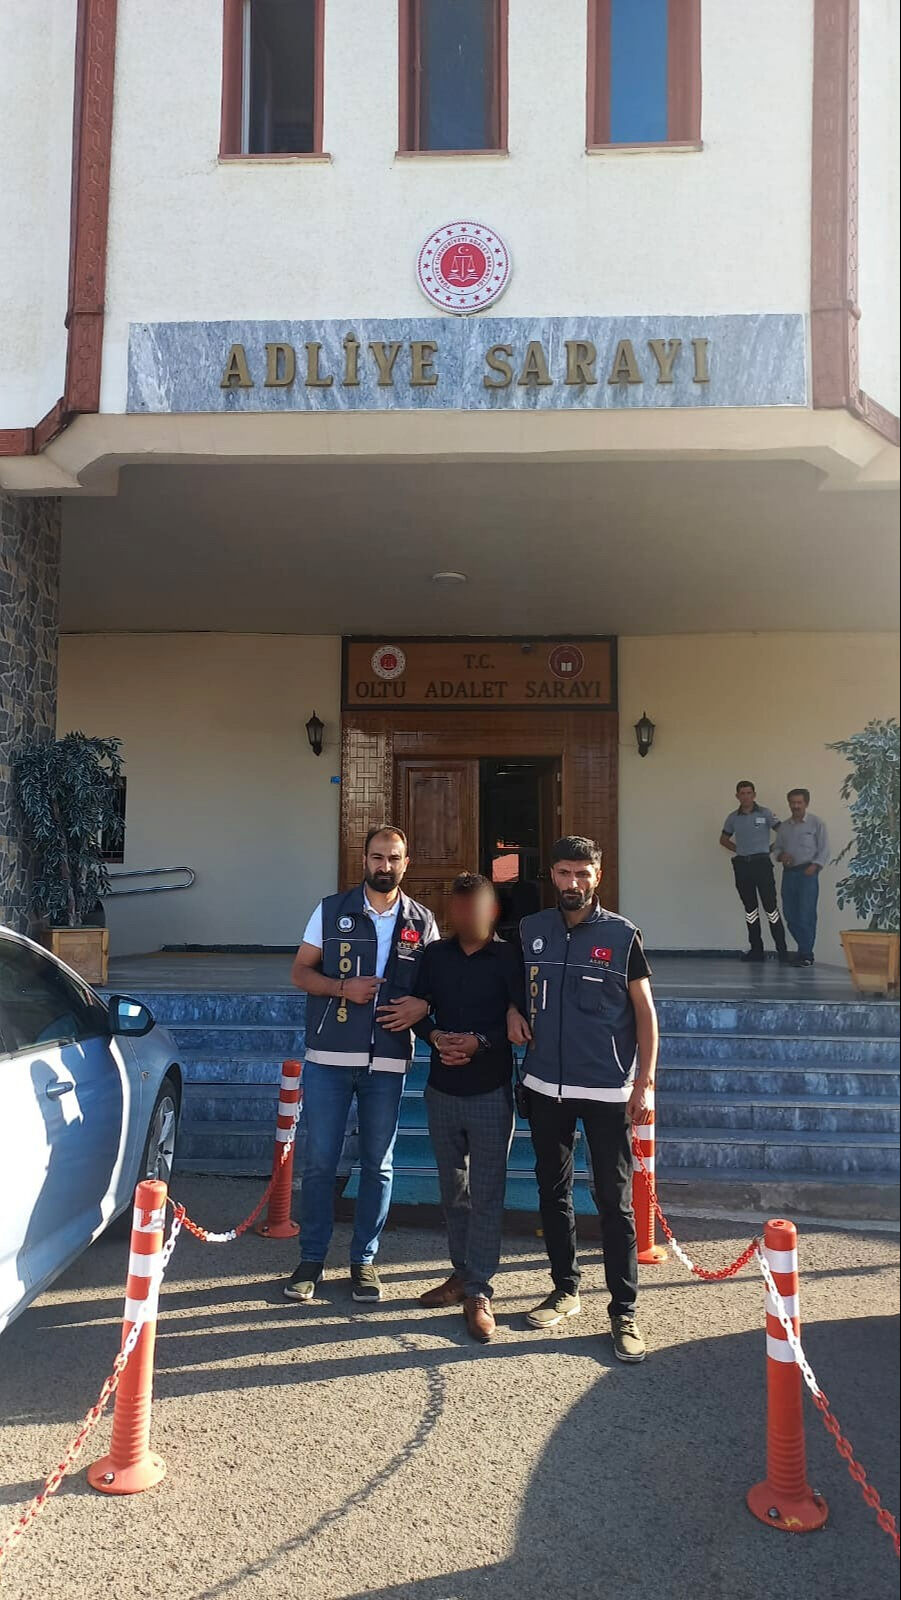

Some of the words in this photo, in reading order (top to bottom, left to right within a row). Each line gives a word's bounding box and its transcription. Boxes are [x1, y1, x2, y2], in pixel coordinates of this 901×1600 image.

[220, 331, 439, 388] ADLİYE
[483, 338, 710, 388] SARAYI
[463, 653, 495, 669] T.C.
[355, 681, 406, 698] OLTU
[424, 681, 508, 698] ADALET
[525, 681, 601, 698] SARAYI
